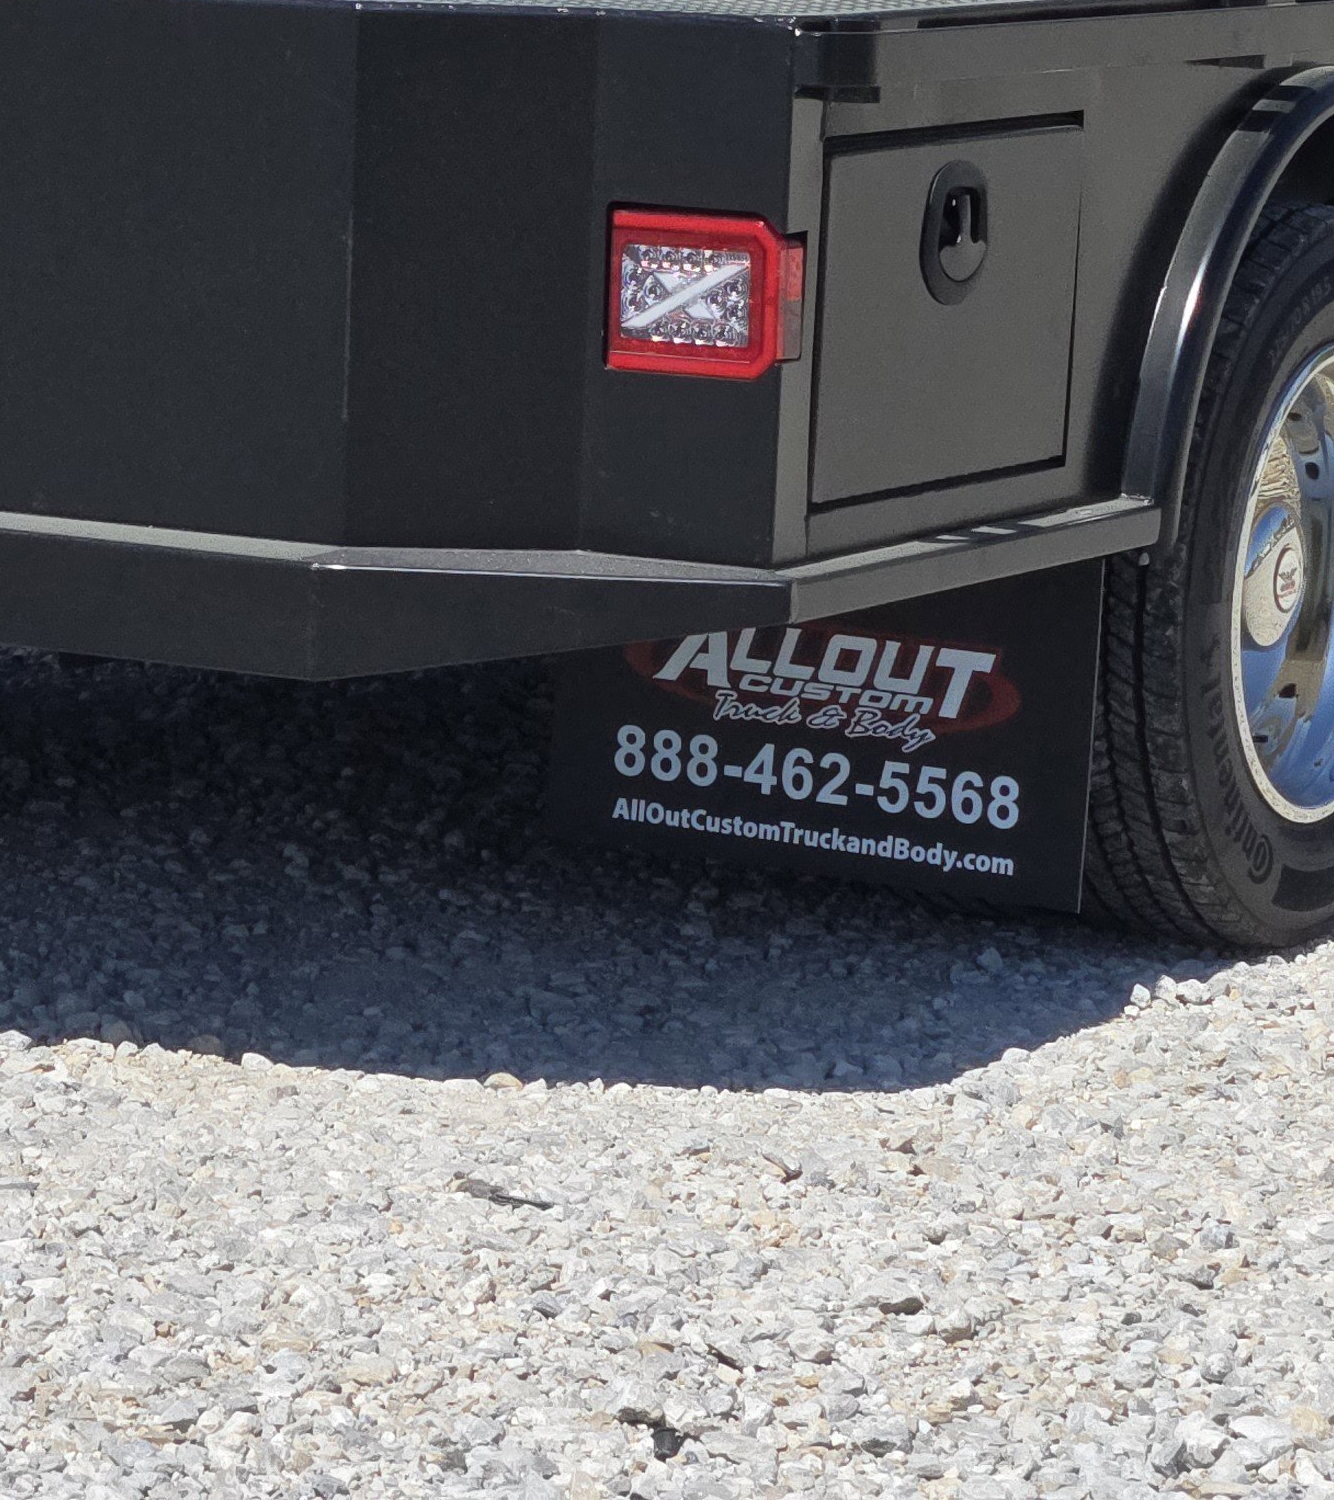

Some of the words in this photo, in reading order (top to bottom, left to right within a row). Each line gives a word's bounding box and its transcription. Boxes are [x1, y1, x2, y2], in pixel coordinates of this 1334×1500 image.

[652, 627, 997, 720] ALLOUT
[739, 673, 935, 716] CUSTOM
[712, 689, 803, 726] Truck
[806, 704, 848, 731] &
[844, 706, 937, 754] Body
[613, 723, 1020, 830] 888-462-5568
[611, 796, 1015, 877] AllOutCustomTruckandBody.com
